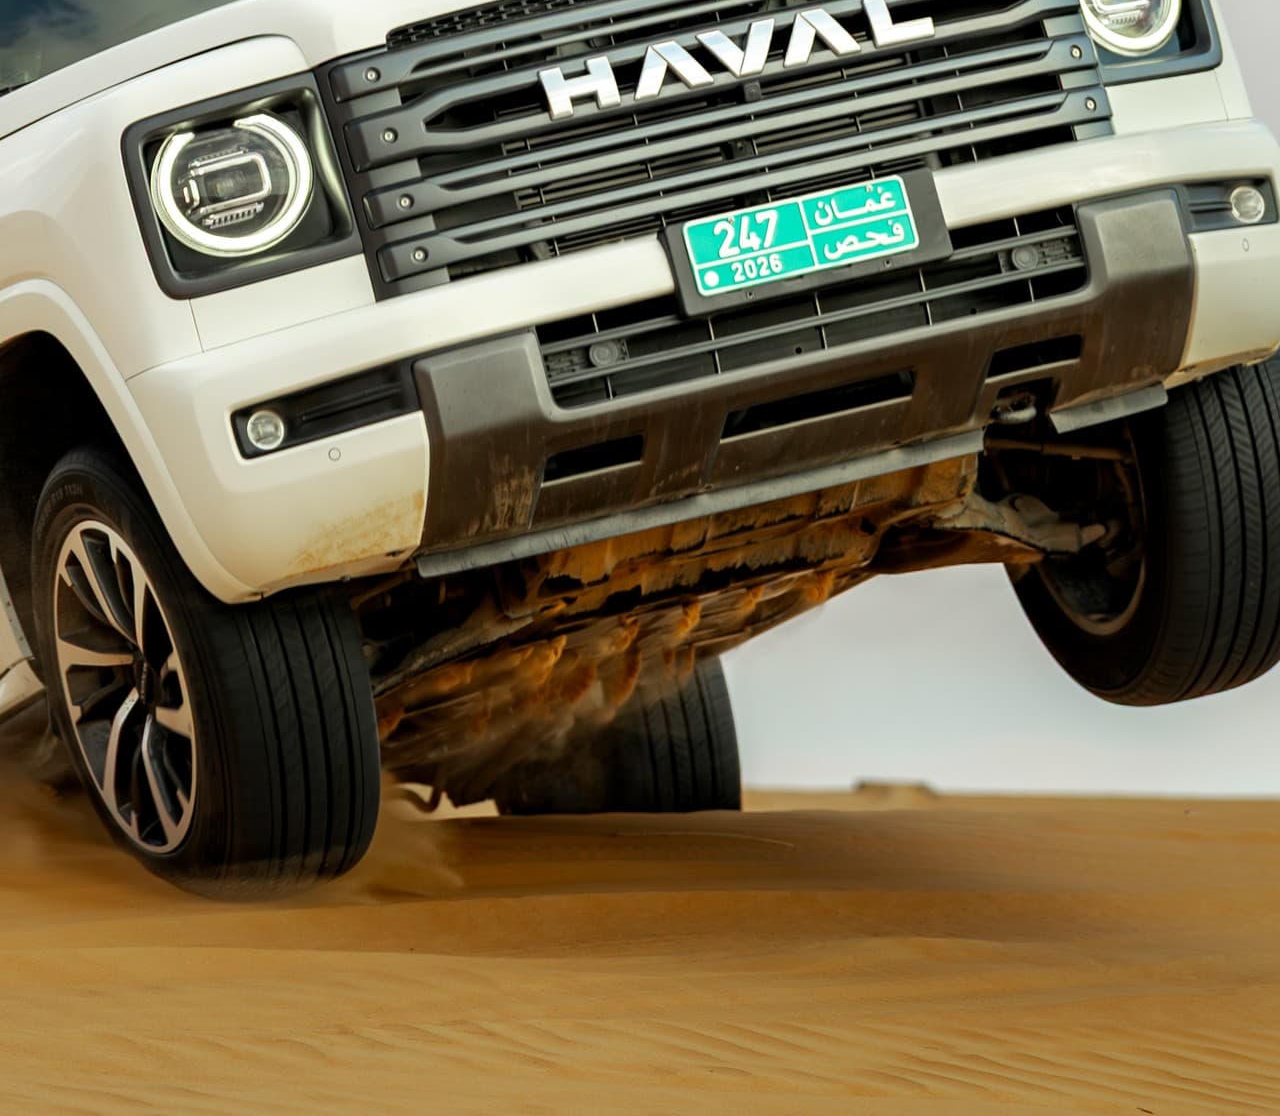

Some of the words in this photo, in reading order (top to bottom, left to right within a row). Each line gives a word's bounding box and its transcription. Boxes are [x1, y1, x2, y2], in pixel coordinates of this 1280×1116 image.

[713, 209, 779, 259] 247
[823, 219, 905, 260] فحص
[731, 253, 783, 283] 2026
